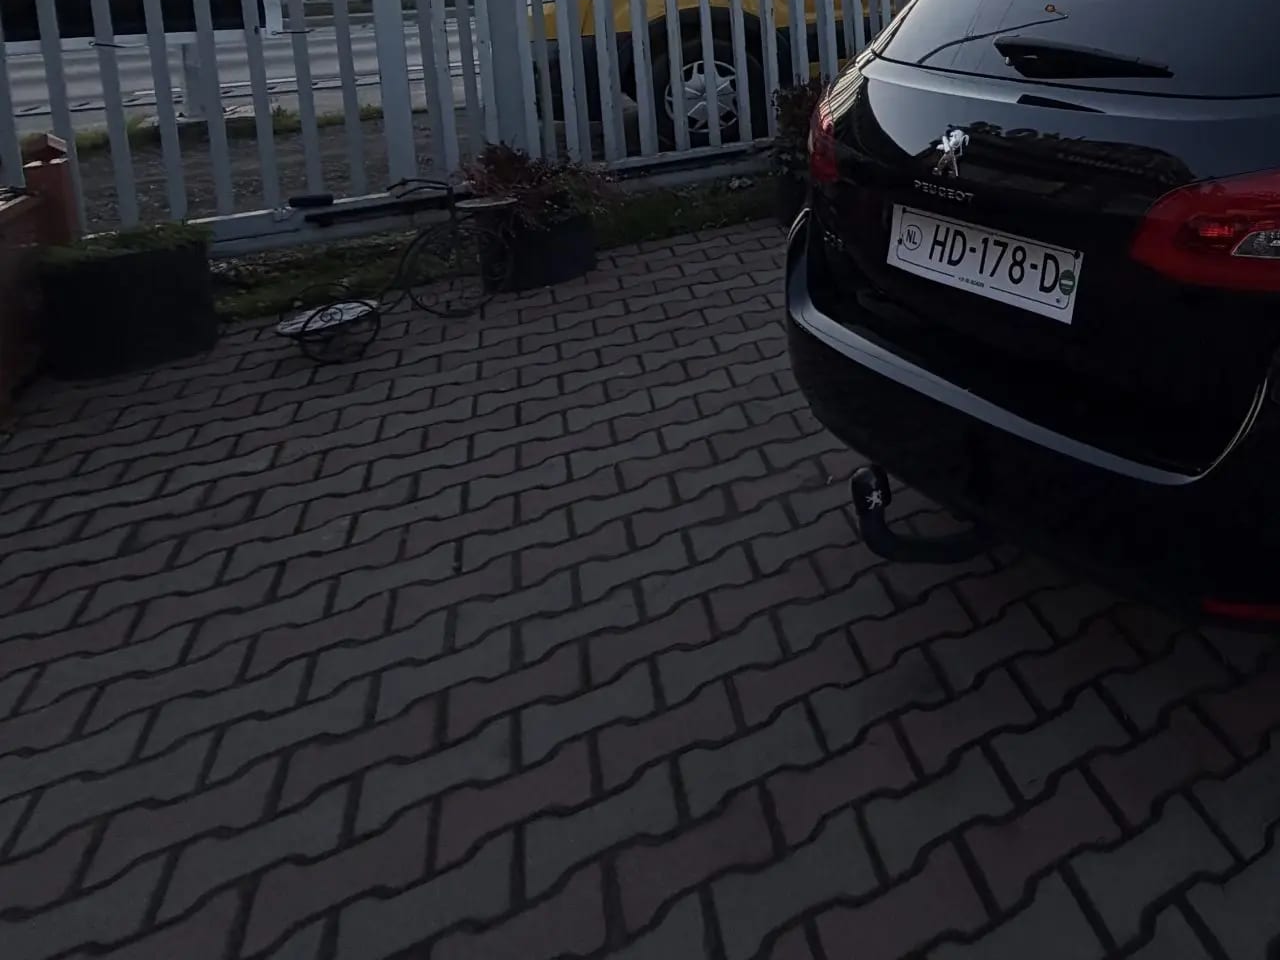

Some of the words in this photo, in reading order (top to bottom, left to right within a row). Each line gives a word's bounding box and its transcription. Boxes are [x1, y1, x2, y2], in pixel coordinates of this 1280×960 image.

[913, 179, 975, 203] PEUGEOT
[906, 229, 918, 246] NL
[928, 224, 1060, 293] HD-178-D
